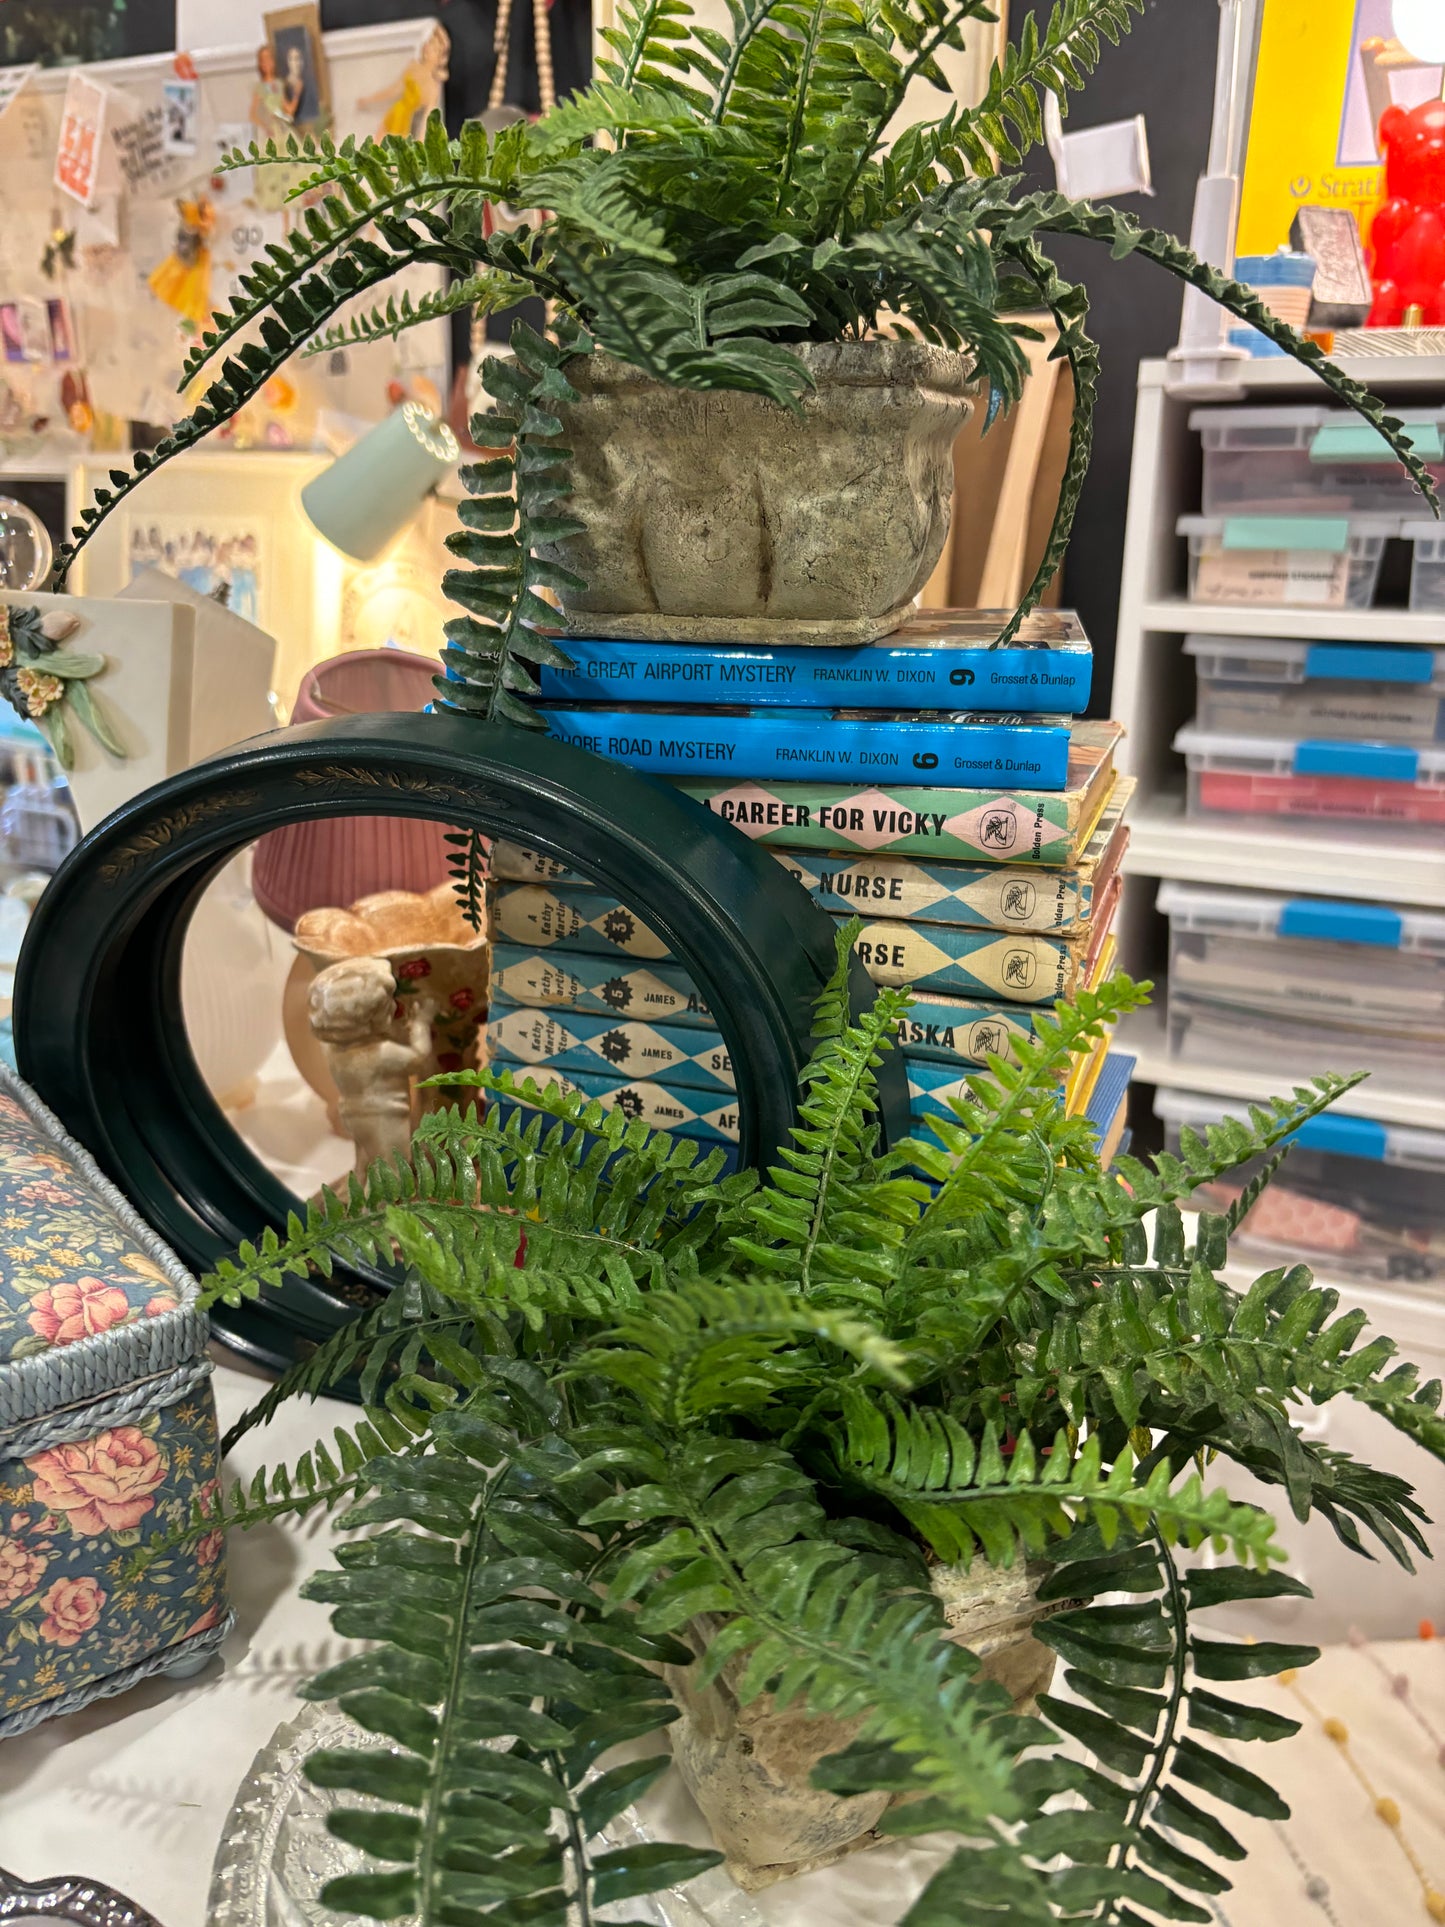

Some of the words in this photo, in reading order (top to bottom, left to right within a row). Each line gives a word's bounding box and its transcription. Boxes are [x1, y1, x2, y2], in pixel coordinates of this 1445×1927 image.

[587, 661, 638, 679] GREAT
[644, 663, 714, 682] AIRPORT
[719, 665, 797, 683] MYSTERY
[813, 668, 873, 683] FRANKLIN
[875, 670, 891, 683] W.
[896, 670, 936, 683] DIXON
[990, 672, 1029, 685] Grosset
[1029, 673, 1039, 685] &
[1040, 674, 1076, 686] Dunlap
[551, 733, 603, 753] HORE
[608, 737, 653, 756] ROAD
[659, 740, 736, 761] MYSTERY
[775, 748, 833, 764] FRANKLIN
[837, 750, 854, 764] W.
[859, 752, 899, 766] DIXON
[954, 757, 993, 771] Grosset
[994, 759, 1003, 771] &
[1004, 759, 1041, 774] Dunlap
[721, 800, 810, 827] CAREER
[819, 806, 864, 831] FOR
[872, 810, 947, 837] VICKY
[1034, 803, 1045, 828] Press
[820, 872, 904, 901] NURSE
[528, 914, 538, 923] A
[541, 902, 554, 936] Kathy
[555, 902, 566, 940] Martin
[569, 905, 583, 938] Story
[1054, 902, 1065, 928] olden
[612, 922, 627, 933] 3
[527, 979, 538, 988] A
[555, 968, 565, 997] artin
[612, 989, 624, 999] 5
[643, 993, 676, 1006] JAMES
[518, 1030, 529, 1039] A
[531, 1019, 544, 1052] Kathy
[545, 1019, 555, 1056] Martin
[558, 1025, 570, 1054] Story
[610, 1042, 622, 1051] 7
[641, 1047, 673, 1060] JAMES
[711, 1054, 733, 1072] SE
[654, 1106, 685, 1119] JAMES
